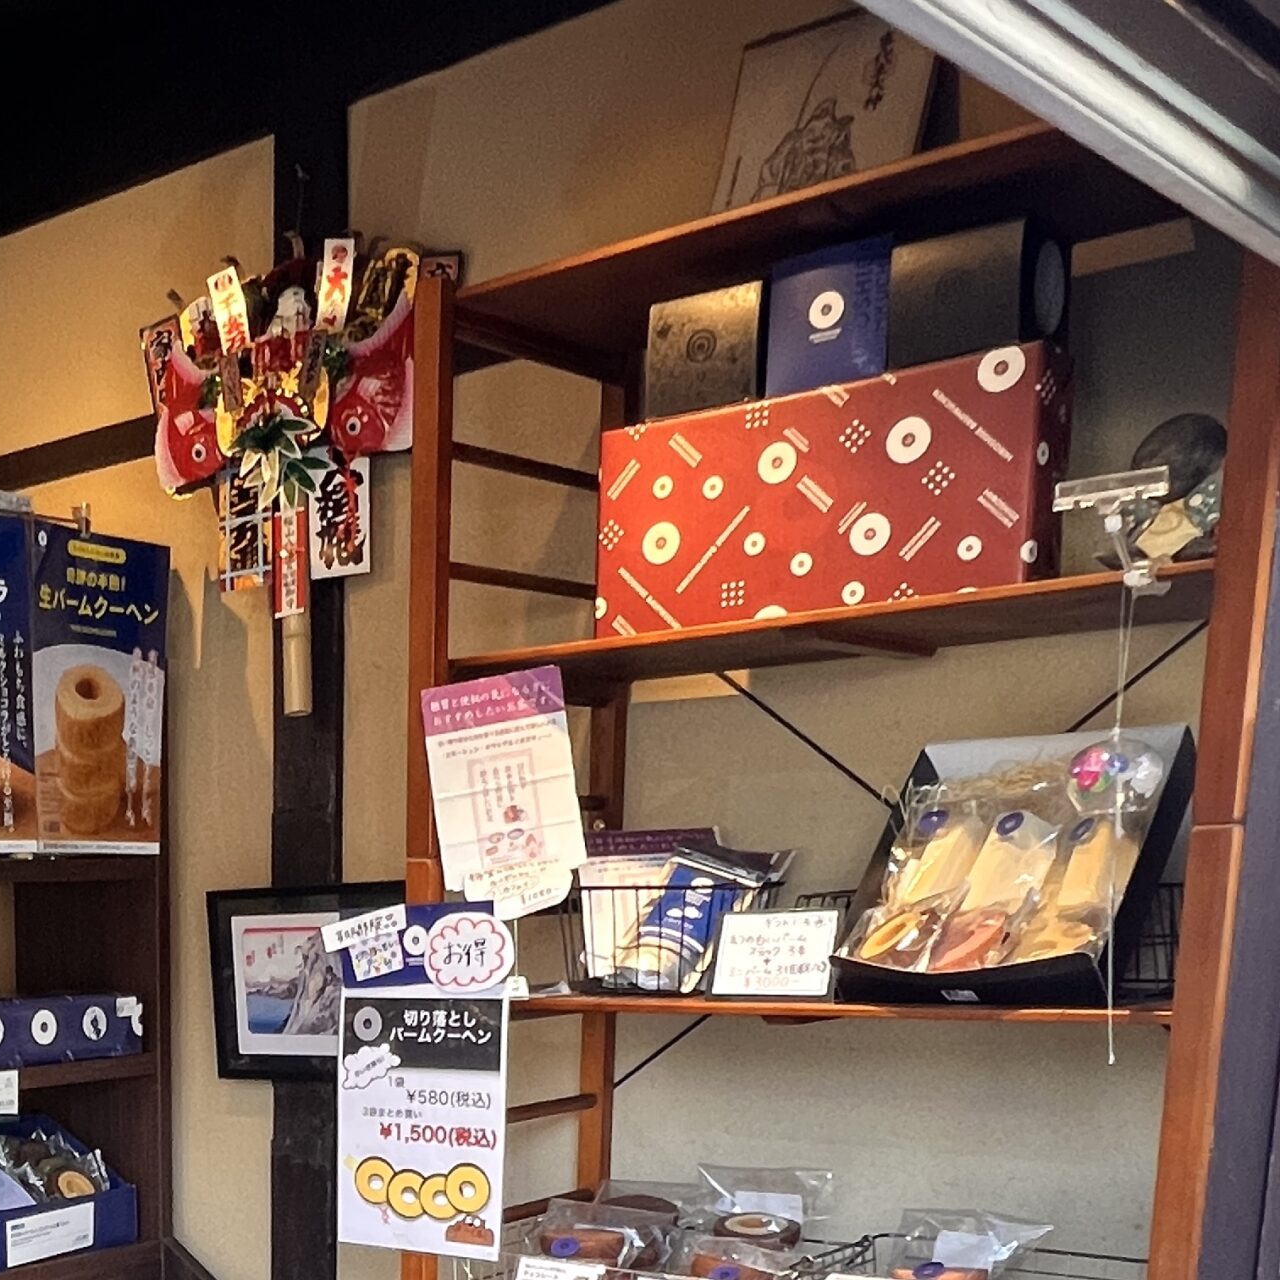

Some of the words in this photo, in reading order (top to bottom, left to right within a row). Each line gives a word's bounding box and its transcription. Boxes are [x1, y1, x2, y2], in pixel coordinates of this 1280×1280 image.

[39, 584, 159, 625] 生バームクーヘン
[443, 939, 487, 967] お得
[403, 1010, 476, 1027] 切り落とし
[389, 1027, 492, 1044] バームクーヘン
[407, 1090, 491, 1110] ¥580(税込)
[379, 1122, 497, 1150] ¥1,500(税込)
